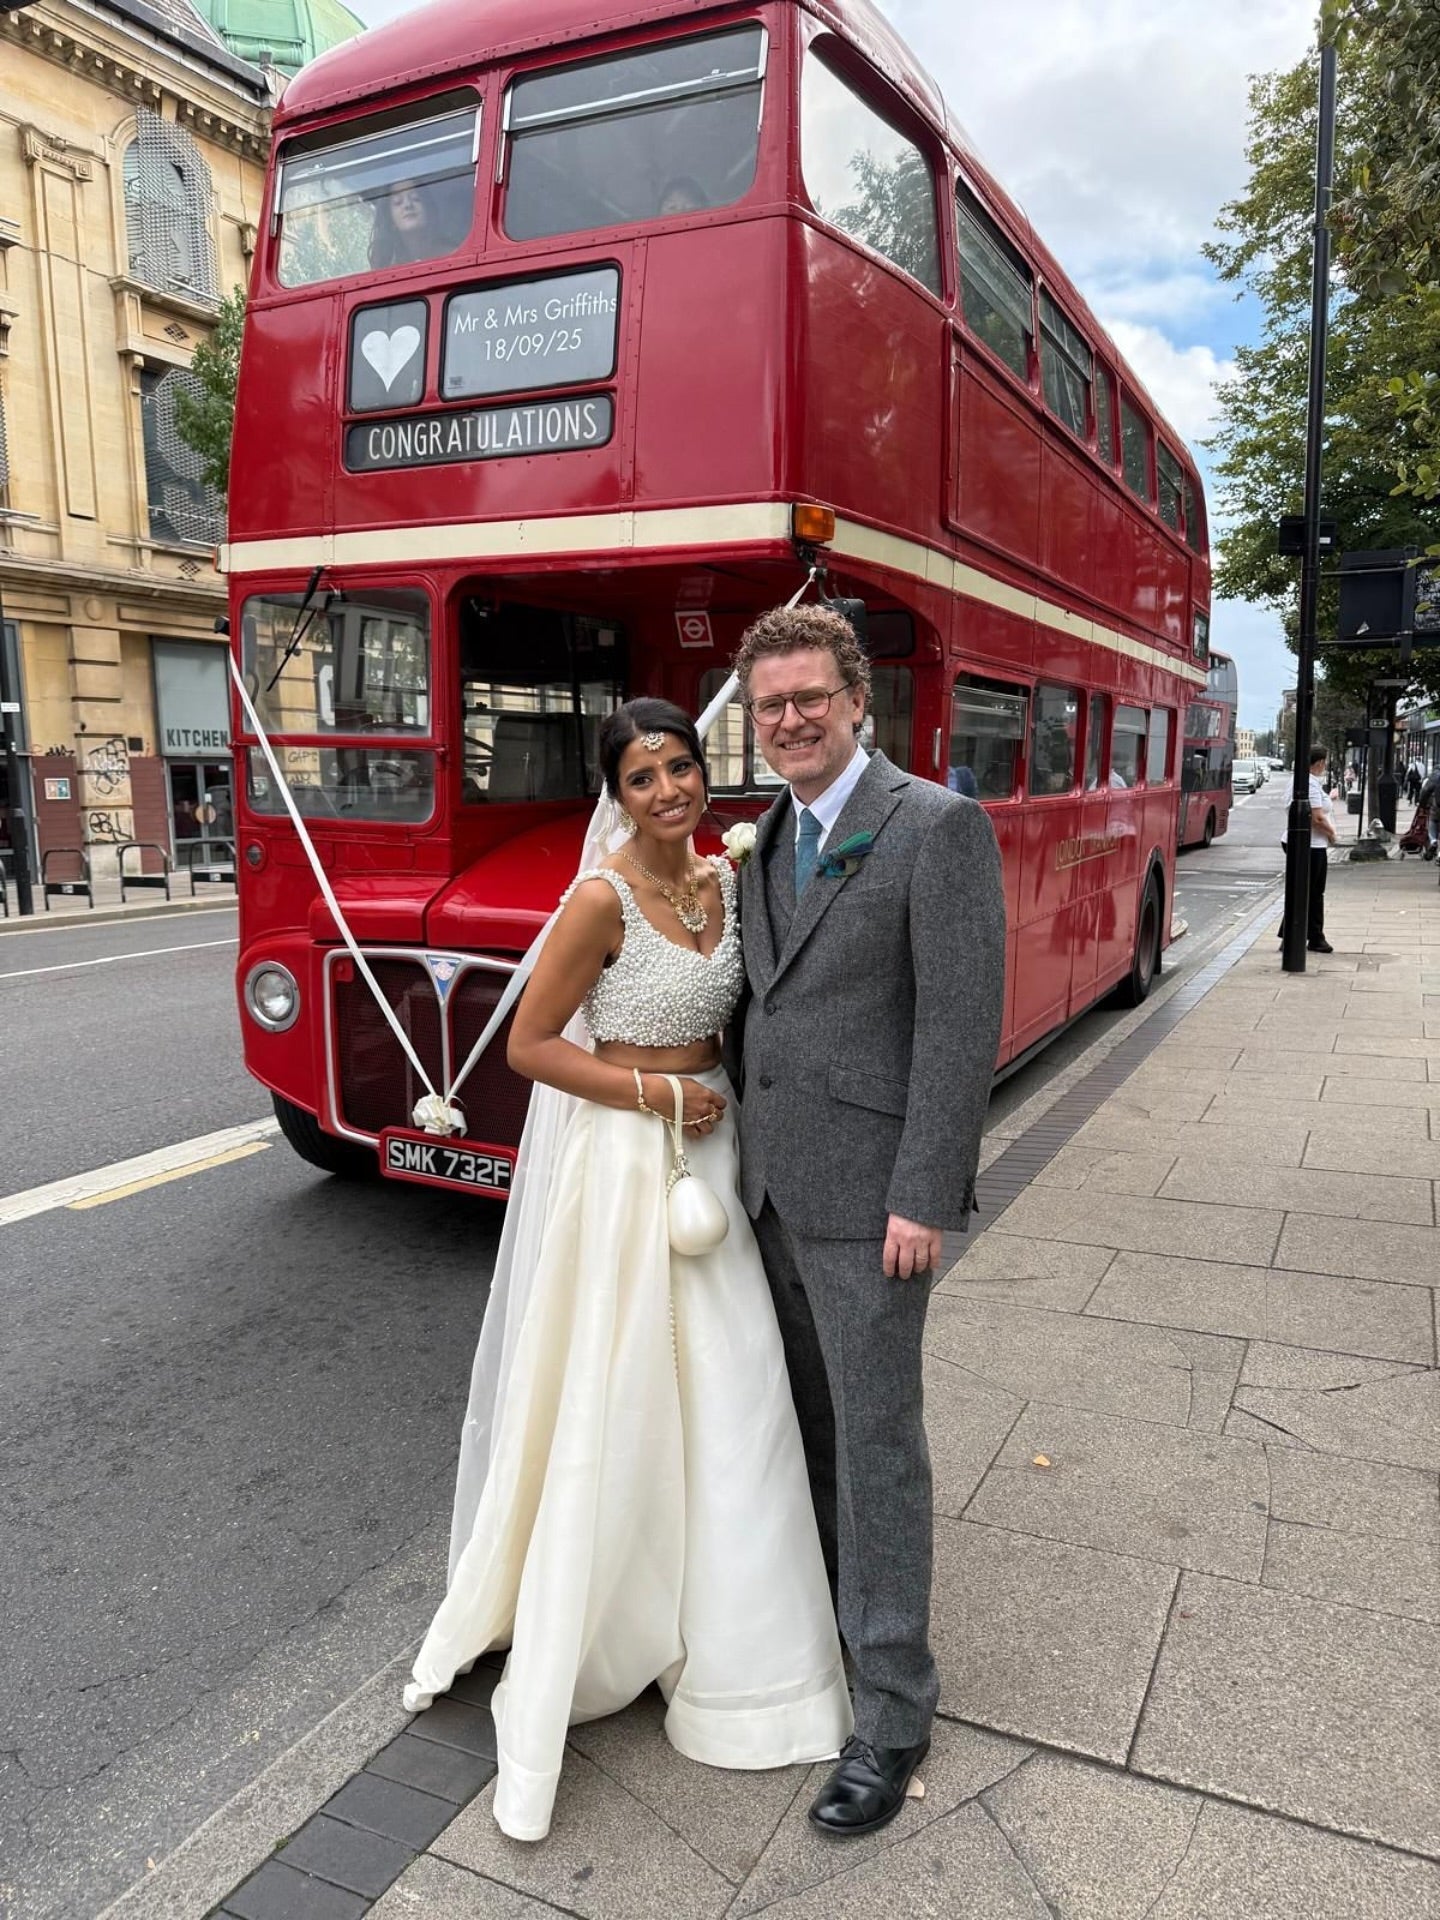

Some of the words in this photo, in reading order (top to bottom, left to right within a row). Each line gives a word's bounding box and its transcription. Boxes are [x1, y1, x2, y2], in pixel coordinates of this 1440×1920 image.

[454, 311, 478, 335] Mr
[484, 308, 498, 329] &
[504, 302, 538, 327] Mrs
[544, 290, 618, 321] Griffiths
[484, 328, 583, 362] 18/09/25
[368, 402, 598, 461] CONGRATULATIONS
[166, 728, 229, 748] KITCHEN
[389, 1140, 437, 1174] SMK
[443, 1150, 510, 1186] 732F
